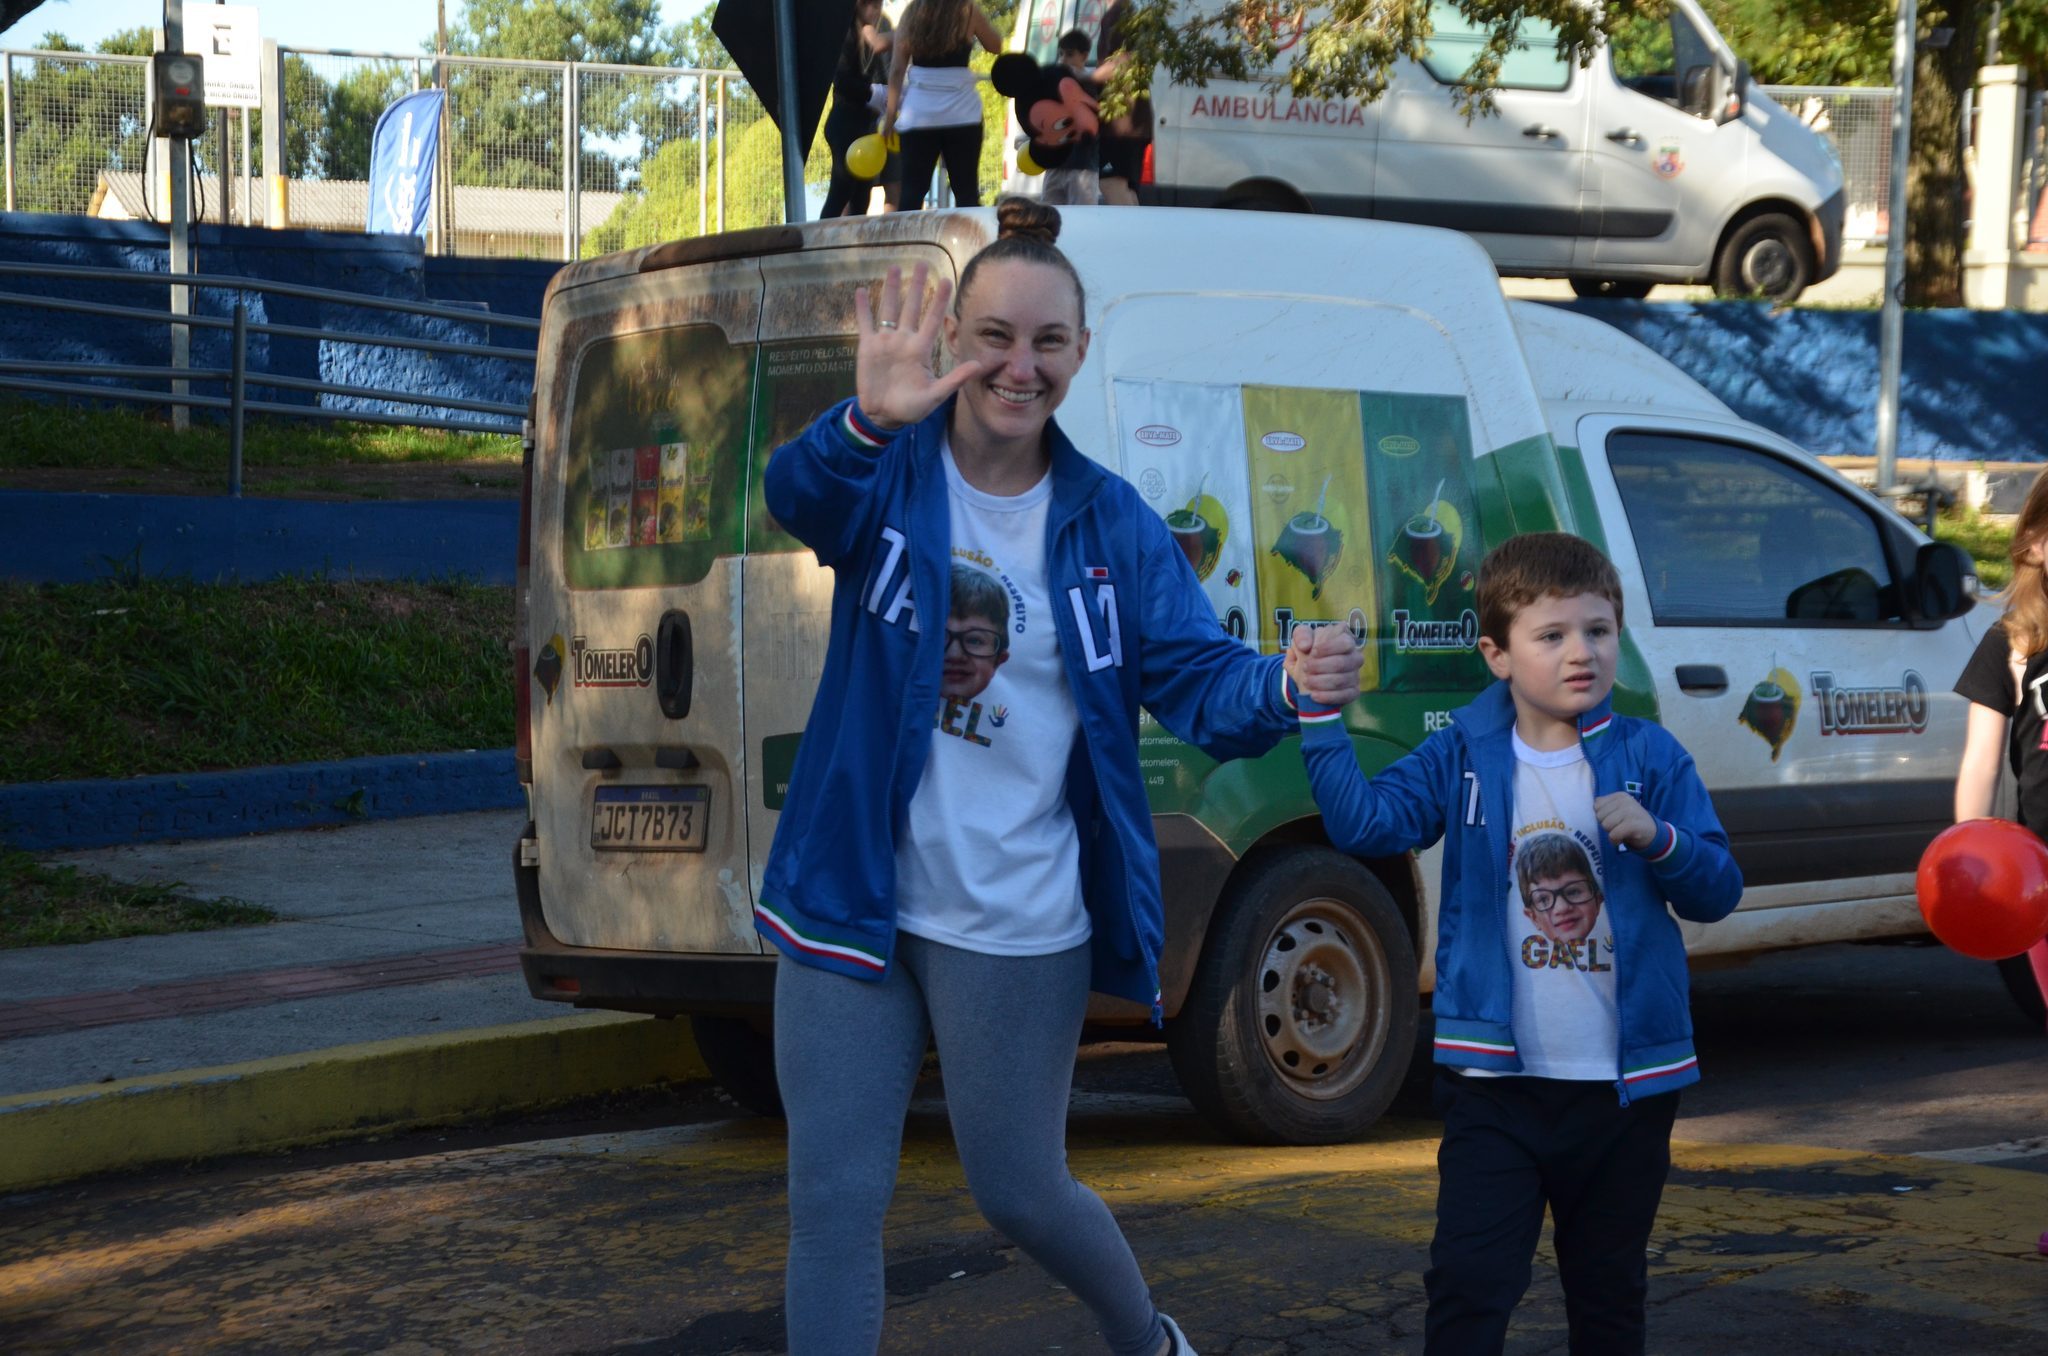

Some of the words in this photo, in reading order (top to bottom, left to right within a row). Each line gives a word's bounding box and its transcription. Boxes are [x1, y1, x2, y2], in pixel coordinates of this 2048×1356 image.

[767, 363, 813, 377] MOMENTO
[814, 363, 828, 373] DO
[811, 348, 834, 361] PELO
[835, 346, 854, 357] SEU
[951, 546, 994, 569] LUSÃO
[1001, 574, 1026, 634] RESPEITO
[1393, 608, 1480, 654] TOMELERO
[571, 633, 655, 688] TOMELERO
[1810, 668, 1931, 736] TOMELERO
[601, 805, 693, 841] JCT7B73
[1516, 816, 1566, 838] INCLUSÃO
[1573, 829, 1604, 876] RESPEITO
[1521, 934, 1612, 973] GAEL
